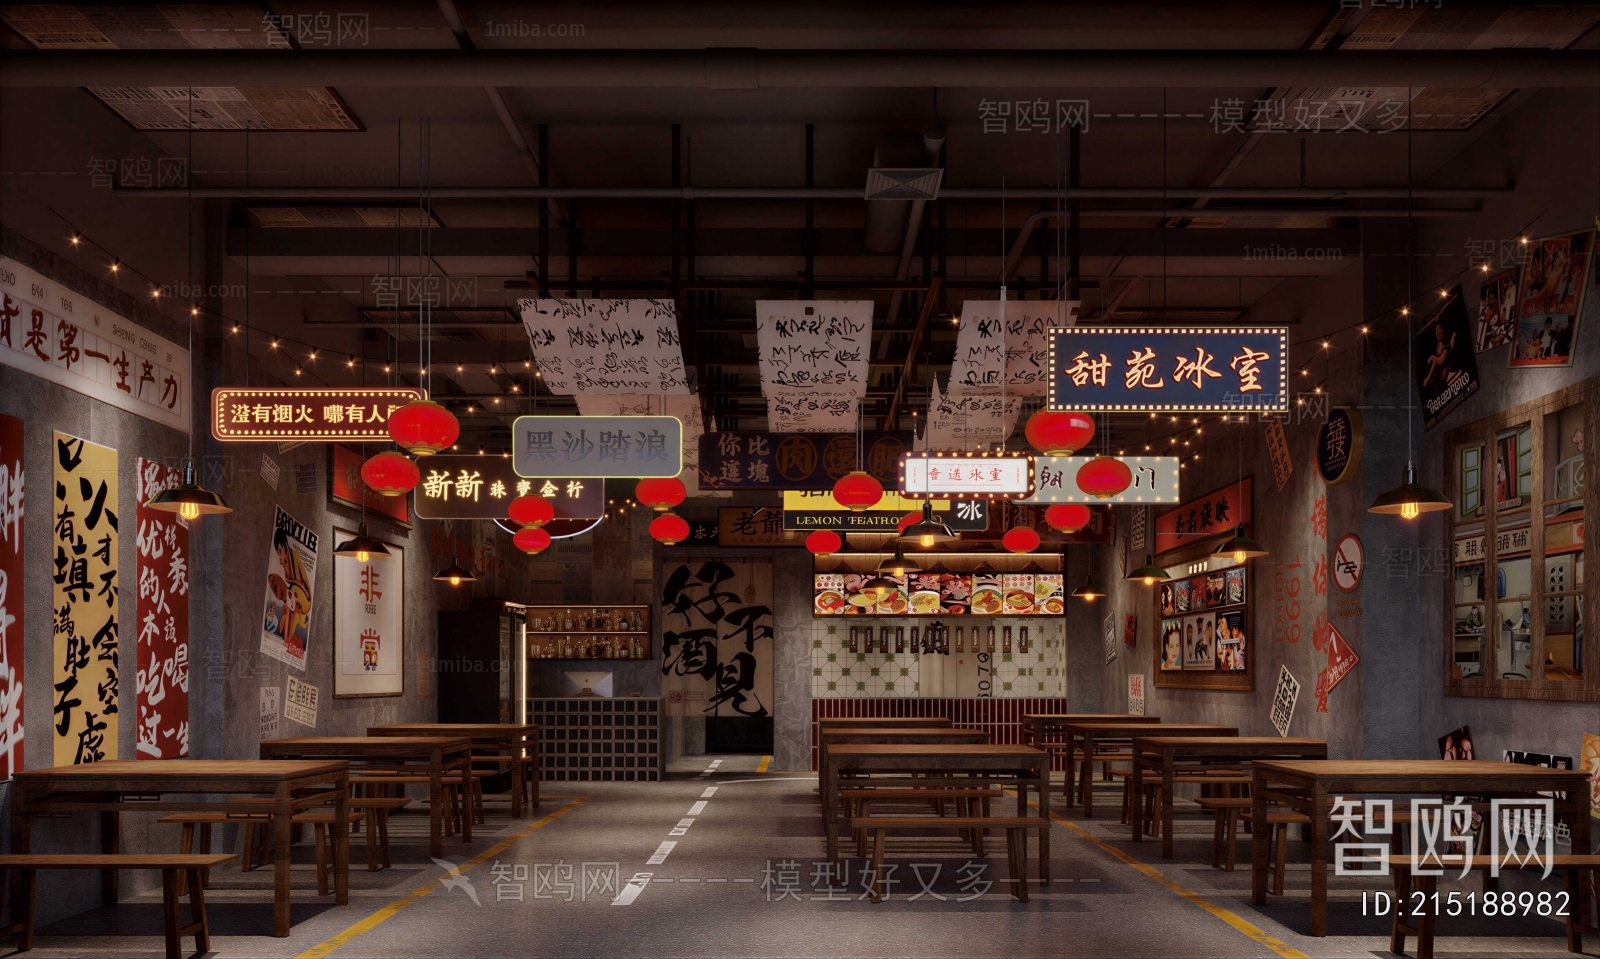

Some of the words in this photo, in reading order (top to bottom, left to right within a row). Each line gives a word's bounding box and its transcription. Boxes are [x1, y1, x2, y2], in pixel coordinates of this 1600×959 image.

[1064, 347, 1270, 392] 甜苑冰室
[523, 429, 670, 463] 黑沙踏浪
[717, 433, 771, 457] 你比
[422, 469, 484, 503] 新新
[796, 516, 842, 525] LEMON
